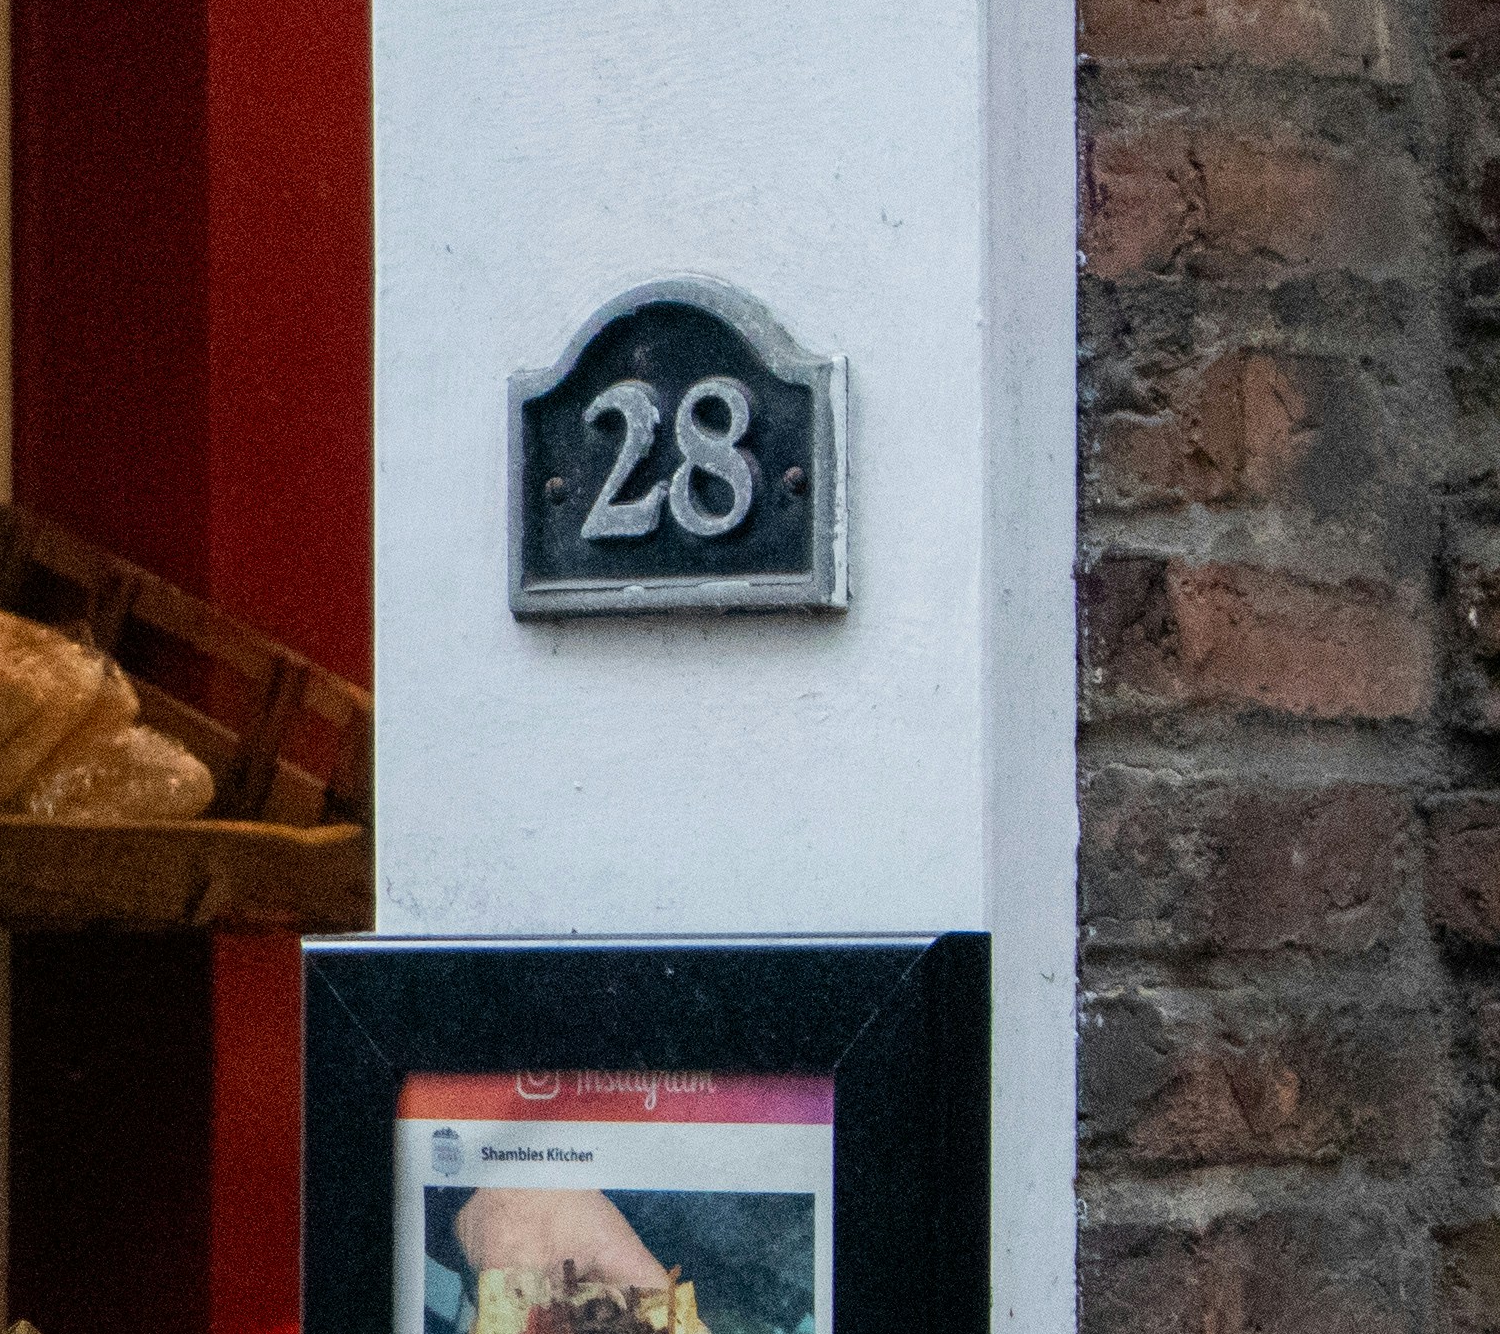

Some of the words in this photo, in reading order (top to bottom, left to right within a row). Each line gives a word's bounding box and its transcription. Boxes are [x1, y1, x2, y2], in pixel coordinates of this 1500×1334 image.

[581, 378, 757, 540] 28
[481, 1146, 544, 1162] Shambles
[547, 1147, 594, 1162] Kitchen
